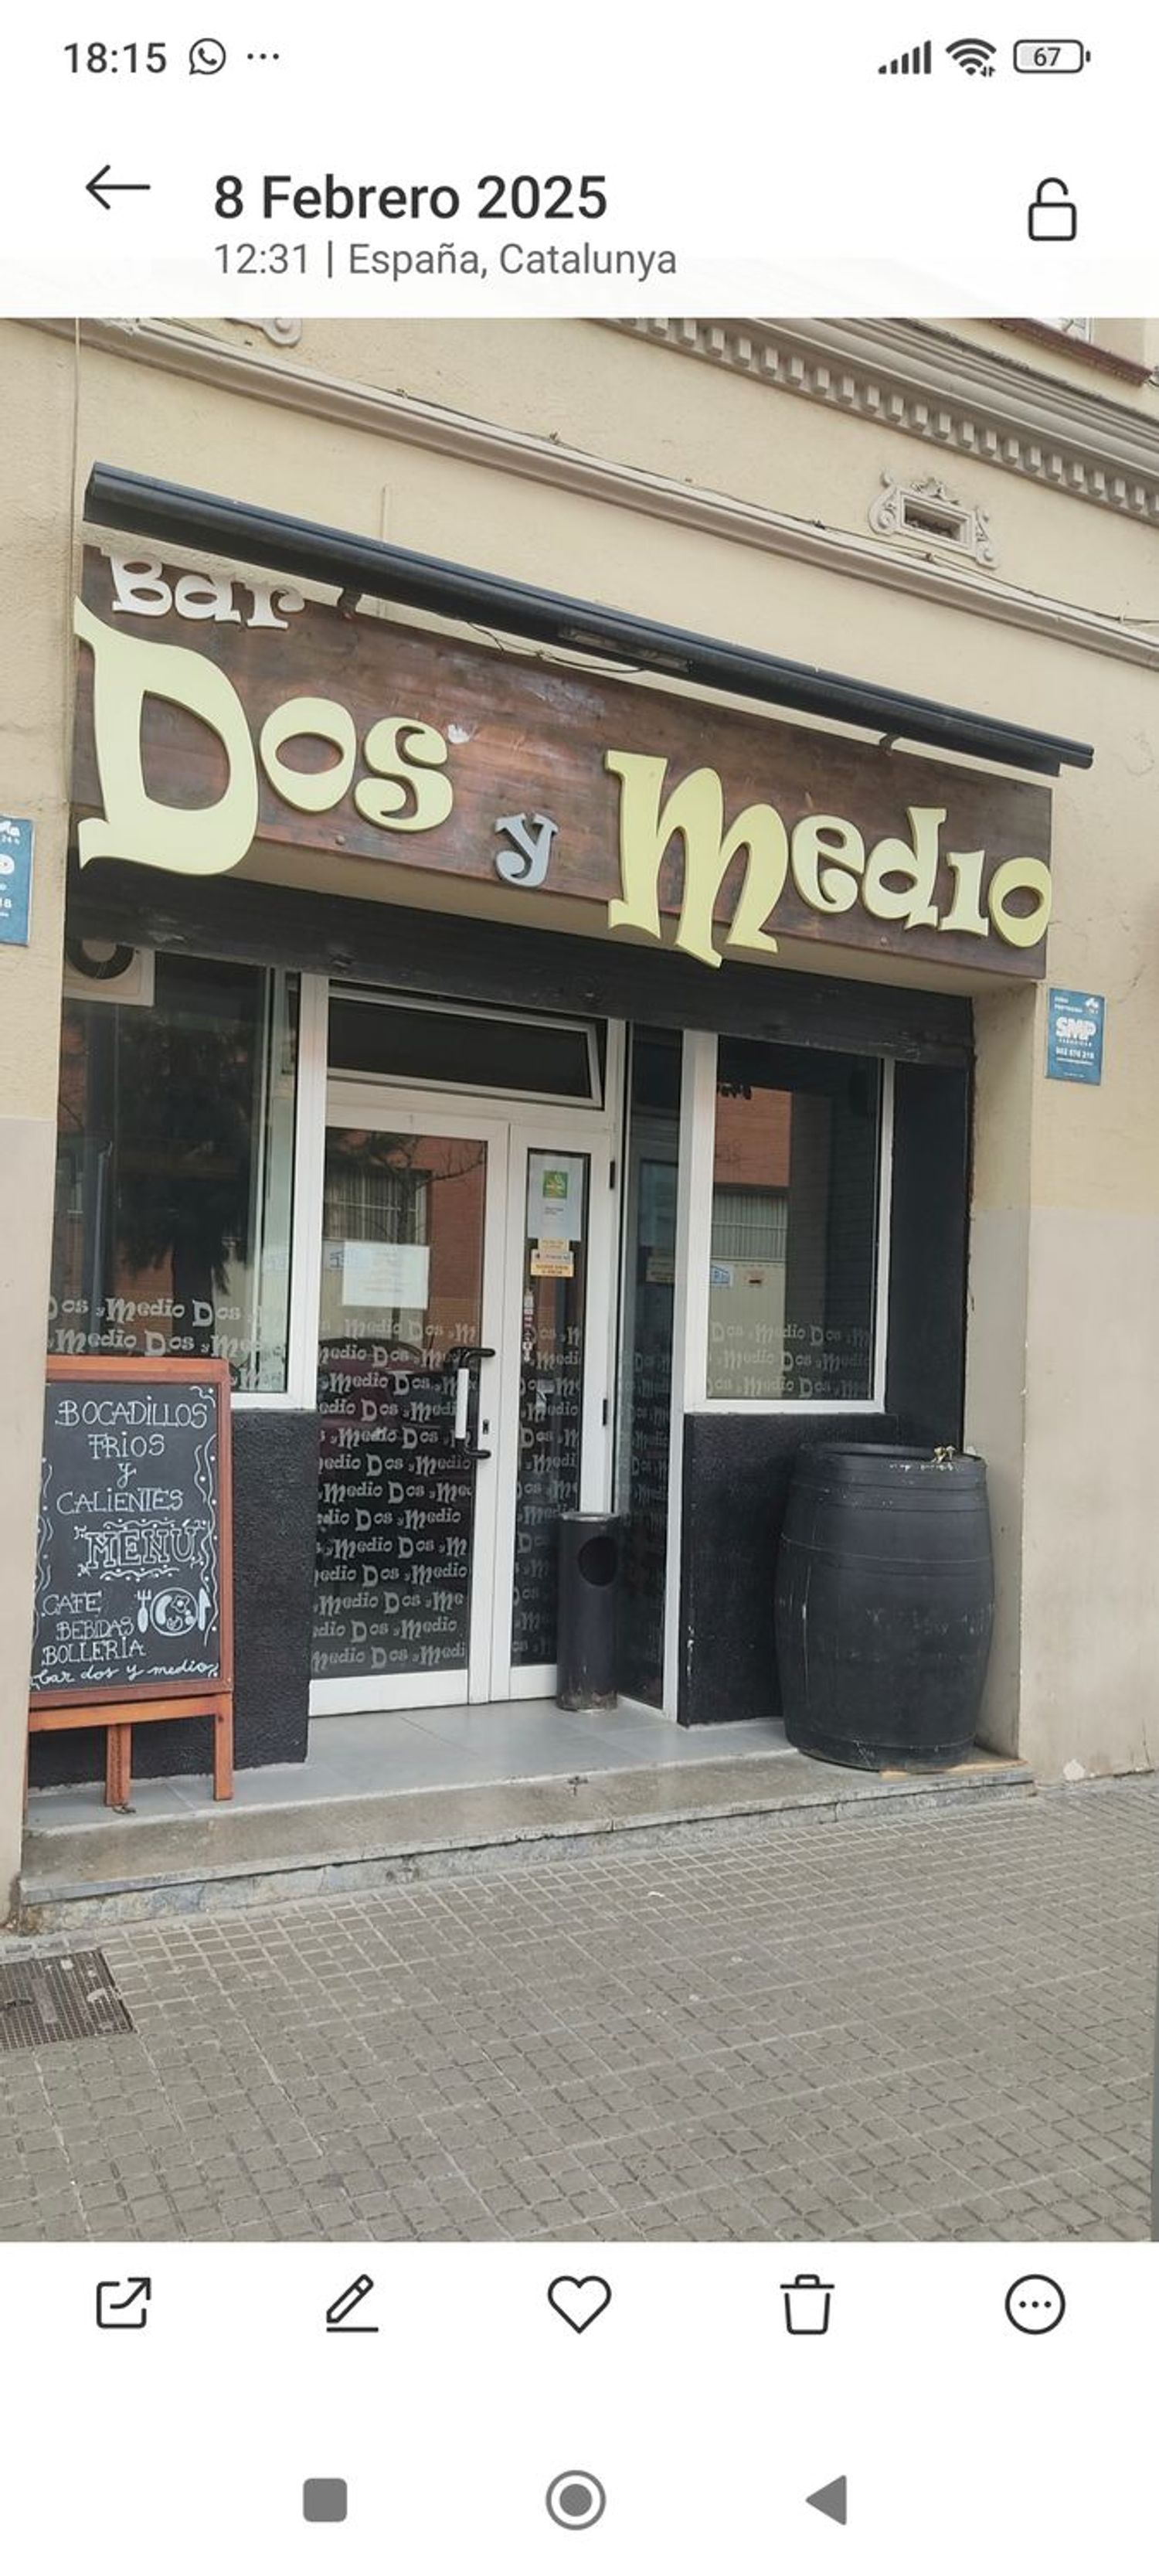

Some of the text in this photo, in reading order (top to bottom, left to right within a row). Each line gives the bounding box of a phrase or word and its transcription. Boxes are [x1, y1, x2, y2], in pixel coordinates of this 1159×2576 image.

[100, 545, 305, 630] Bar
[73, 594, 1053, 969] Dos y Medio
[1055, 1016, 1097, 1040] SMP
[105, 1298, 185, 1324] Medio
[192, 1300, 241, 1328] Dos
[55, 1329, 137, 1354] Medio
[144, 1329, 195, 1356] Dos
[371, 1343, 410, 1368] Dos
[329, 1371, 389, 1395] Medio
[360, 1397, 399, 1422] Dos
[338, 1426, 399, 1450] Medio
[401, 1426, 439, 1450] Dos
[365, 1452, 404, 1477] Dos
[414, 1454, 472, 1478] Medio
[323, 1480, 383, 1505] Medio
[388, 1479, 426, 1505] Dos
[355, 1507, 393, 1532] Dos
[403, 1507, 462, 1531] Medio
[333, 1536, 393, 1560] Medio
[397, 1536, 436, 1559] Dos
[362, 1564, 400, 1587] Dos
[410, 1562, 468, 1586] Medio
[318, 1591, 379, 1617] Medio
[383, 1591, 422, 1614] Dos
[56, 1616, 134, 1641] BEBIDAS
[350, 1618, 389, 1643] Dos
[399, 1616, 458, 1641] Medio
[370, 1645, 409, 1669] Dos
[80, 1664, 119, 1680] dos
[126, 1664, 145, 1681] y
[147, 1659, 214, 1675] medio
